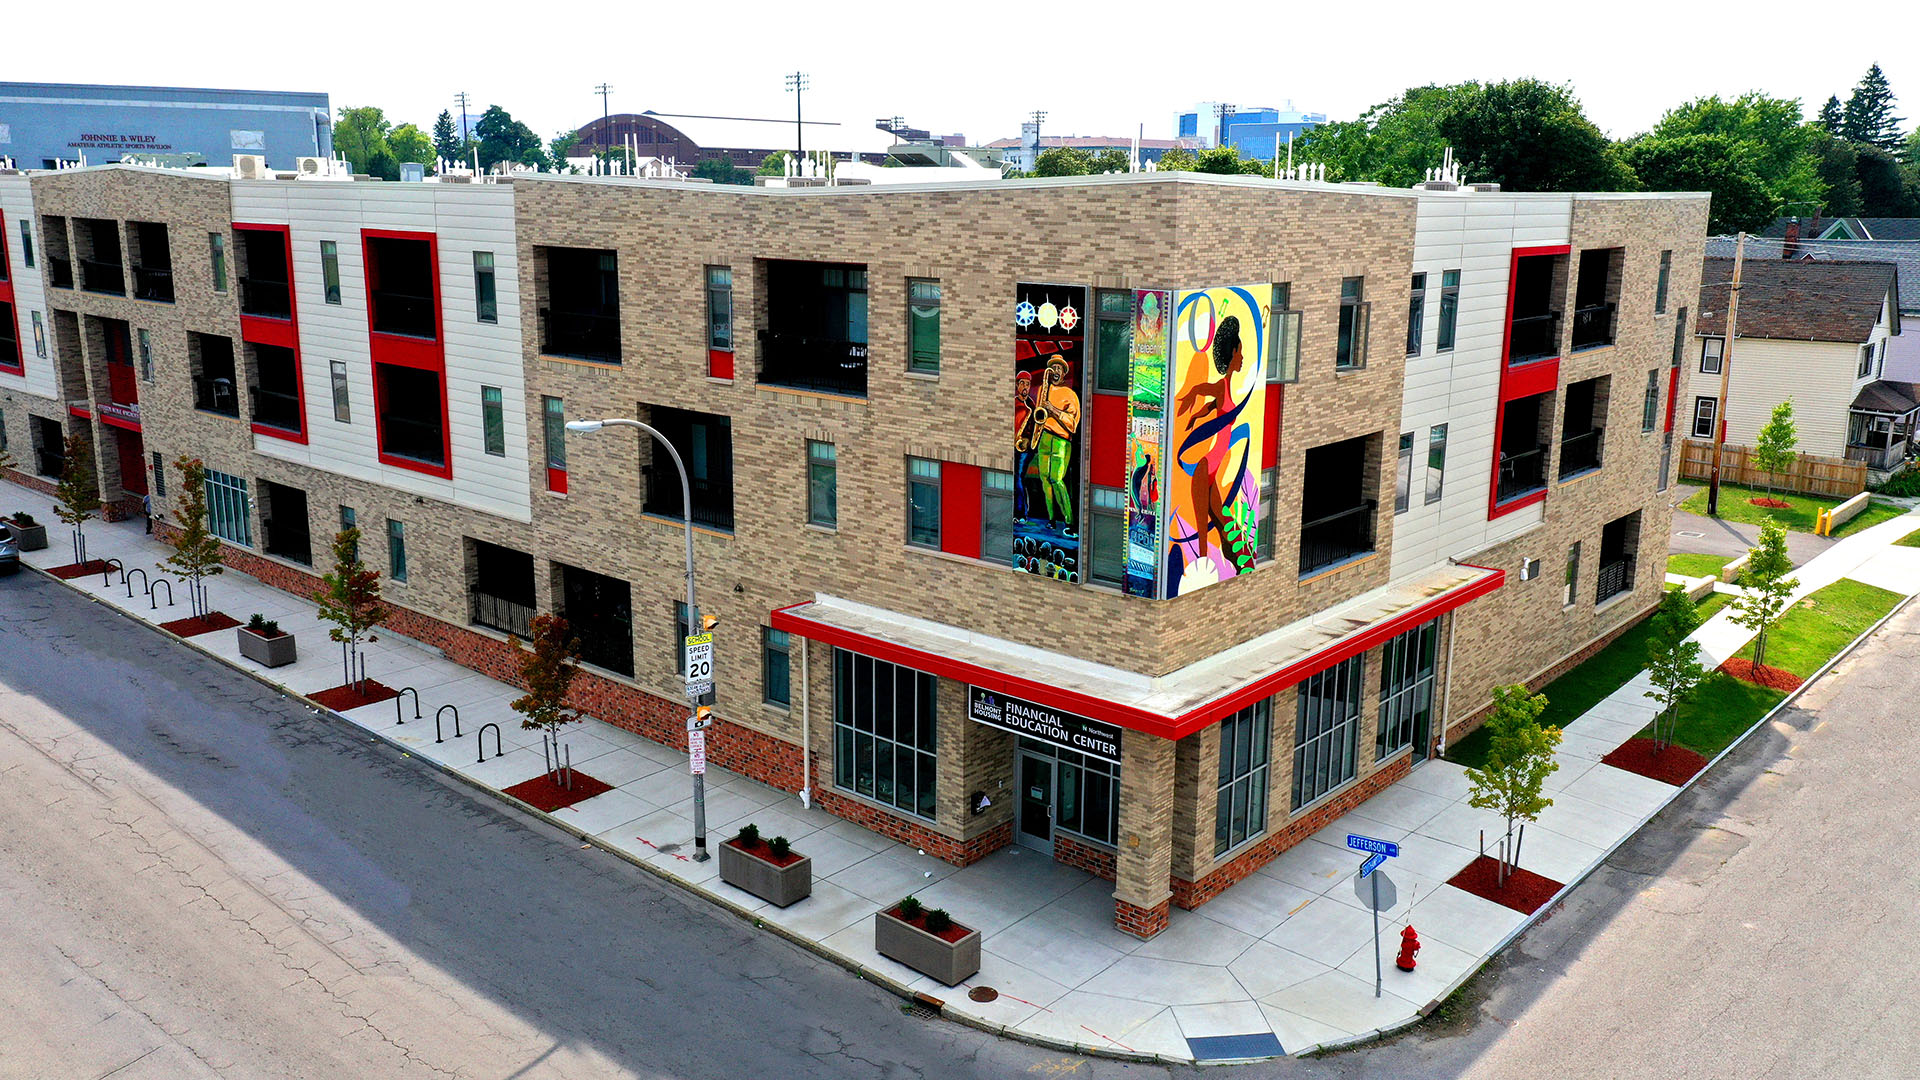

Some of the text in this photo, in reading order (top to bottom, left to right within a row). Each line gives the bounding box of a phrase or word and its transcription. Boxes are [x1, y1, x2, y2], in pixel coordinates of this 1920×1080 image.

[80, 133, 118, 142] JOHNNIE
[128, 135, 156, 143] WILEY
[687, 634, 710, 645] SCHOOL
[688, 645, 710, 655] SPEED
[690, 653, 708, 662] LIMIT
[689, 661, 710, 679] 20
[974, 702, 1002, 715] BELMONT
[974, 708, 1002, 722] HOUSING
[1005, 701, 1064, 728] FINANCIAL
[1005, 713, 1117, 756] EDUCATION CENTER
[1088, 727, 1114, 740] Northwest
[1348, 836, 1387, 853] JEFFERSON
